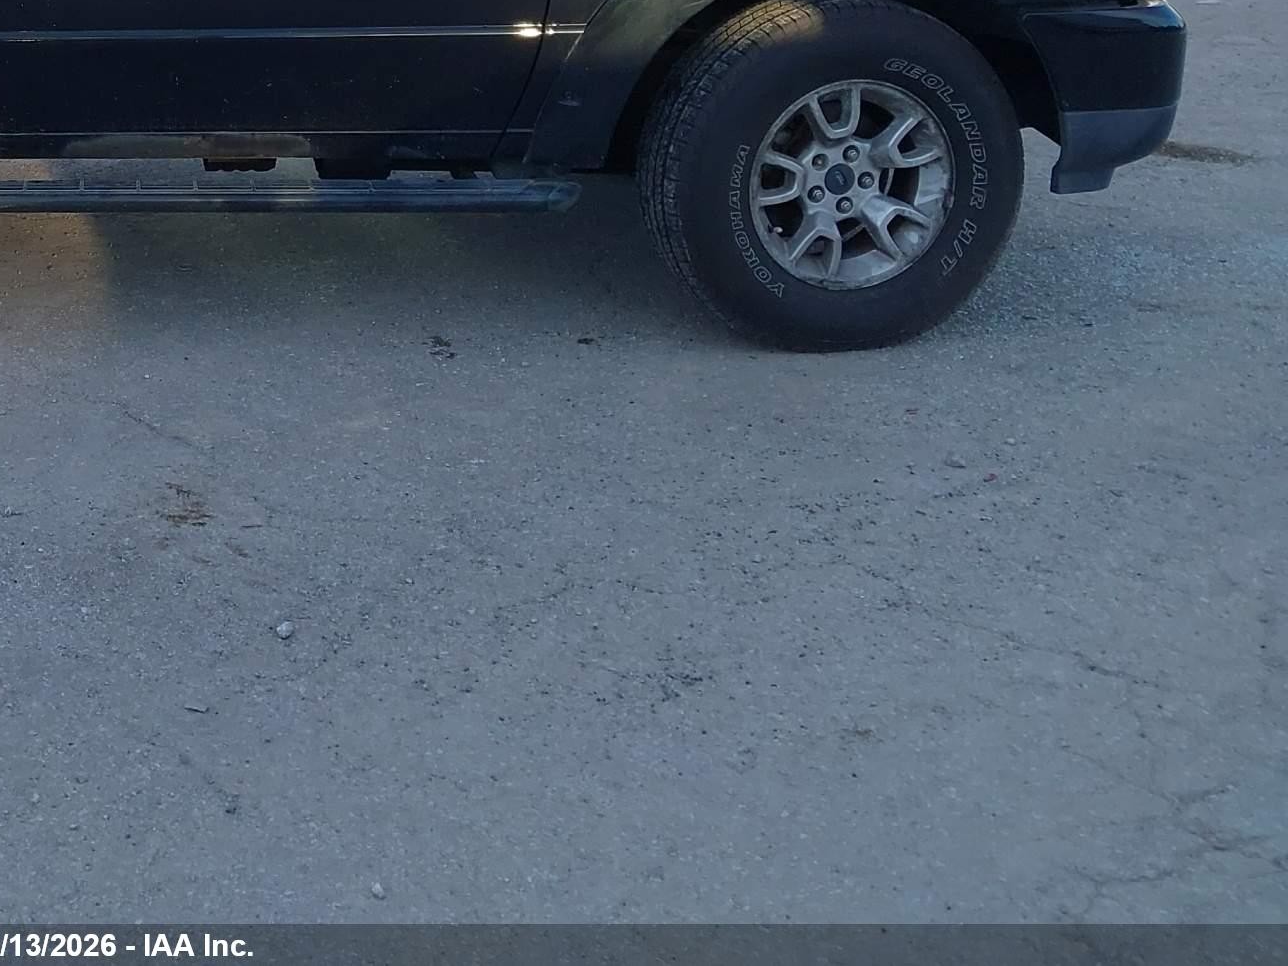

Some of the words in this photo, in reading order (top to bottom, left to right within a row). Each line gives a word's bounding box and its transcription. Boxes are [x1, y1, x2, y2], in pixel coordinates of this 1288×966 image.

[729, 144, 785, 298] YOKOHAMA
[883, 58, 988, 210] GEOLANDAR
[940, 219, 977, 276] H/T
